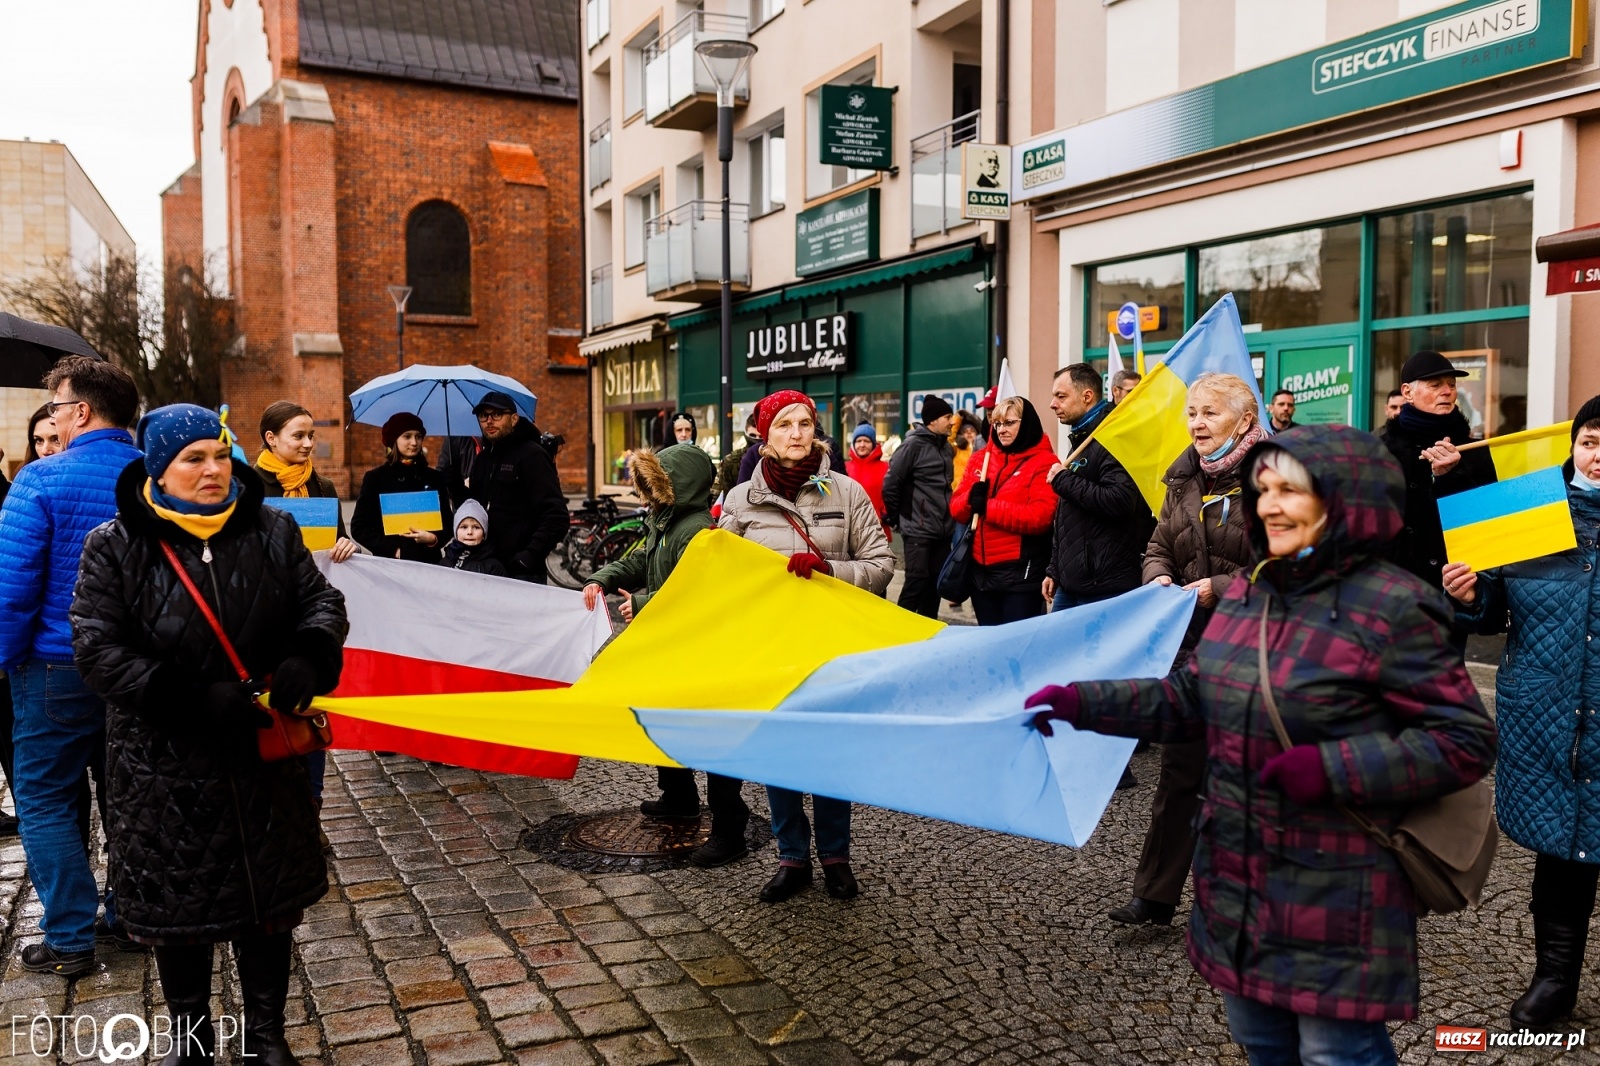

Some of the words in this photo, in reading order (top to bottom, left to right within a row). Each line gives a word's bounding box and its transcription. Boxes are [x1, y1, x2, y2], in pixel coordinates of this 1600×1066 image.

[1320, 36, 1418, 84] STEFCZYK
[1430, 3, 1527, 52] FINANSE
[1461, 37, 1536, 67] PARTNER
[842, 121, 873, 129] ADWOKAT
[831, 146, 856, 155] Barbara
[842, 138, 873, 146] ADWOKAT
[842, 155, 873, 163] ADWOKAT
[1036, 144, 1064, 164] KASA
[1024, 165, 1064, 186] STEFCZYKA
[980, 194, 1007, 205] KASY
[968, 205, 1007, 216] STEFCZYKA
[747, 315, 847, 359] JUBILER
[605, 357, 661, 397] STELLA
[1282, 366, 1341, 392] GRAMY
